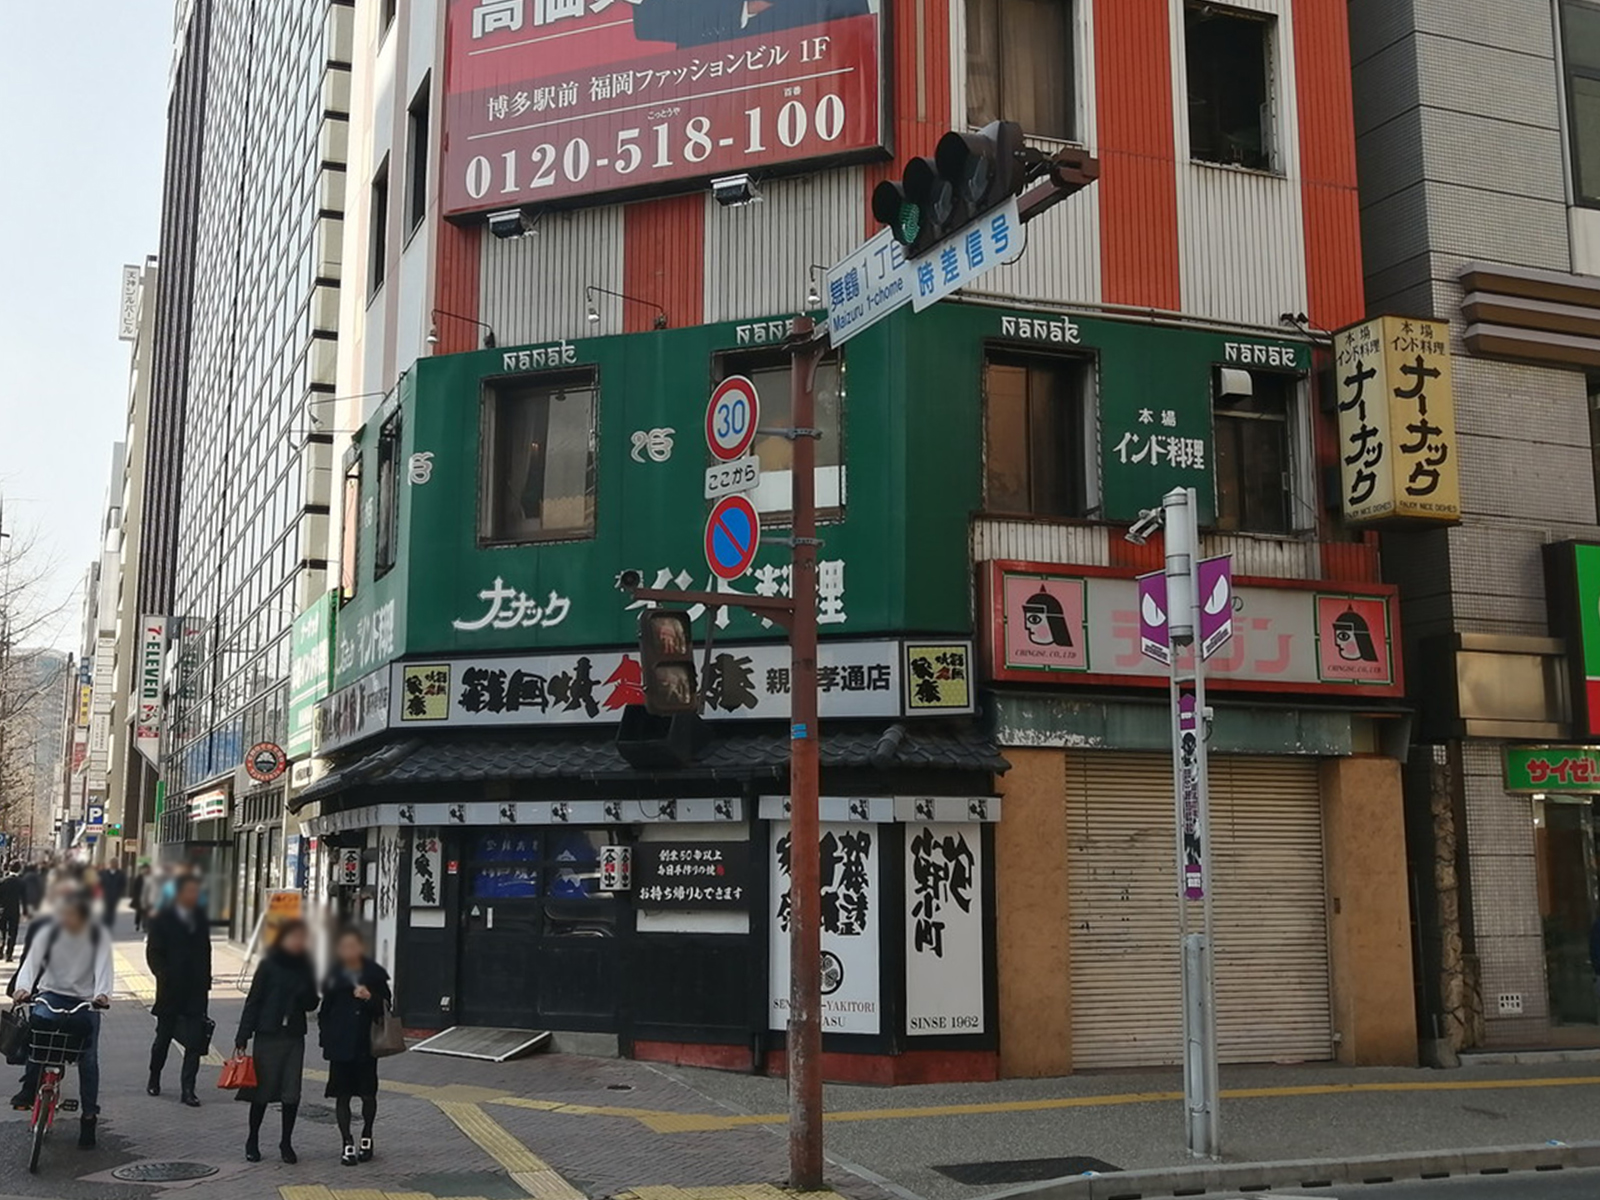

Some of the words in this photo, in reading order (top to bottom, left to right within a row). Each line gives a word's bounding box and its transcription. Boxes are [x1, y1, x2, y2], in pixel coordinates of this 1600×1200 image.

[487, 82, 579, 121] 博多駅前
[588, 45, 790, 100] 福岡ファッションビル
[800, 36, 831, 63] 1F
[465, 94, 846, 199] 0120-518-100
[917, 213, 1009, 298] 時差信号
[833, 303, 864, 333] Maizuru
[867, 277, 904, 312] 1-chome
[1344, 326, 1371, 344] 本場
[1401, 320, 1433, 339] 本場
[1336, 339, 1380, 366] インド料理
[1391, 337, 1445, 356] インド料理
[717, 399, 746, 438] 30
[1138, 407, 1176, 427] 本場
[1393, 354, 1448, 496] ナーナック
[1338, 359, 1383, 506] ナーナック
[1112, 432, 1205, 470] インド料理
[708, 465, 755, 491] ここから
[766, 664, 891, 695] 親孝通店
[89, 806, 103, 823] P
[639, 886, 743, 901] お持ち帰りもできます
[910, 1016, 947, 1030] SINSE
[951, 1015, 979, 1029] 1962
